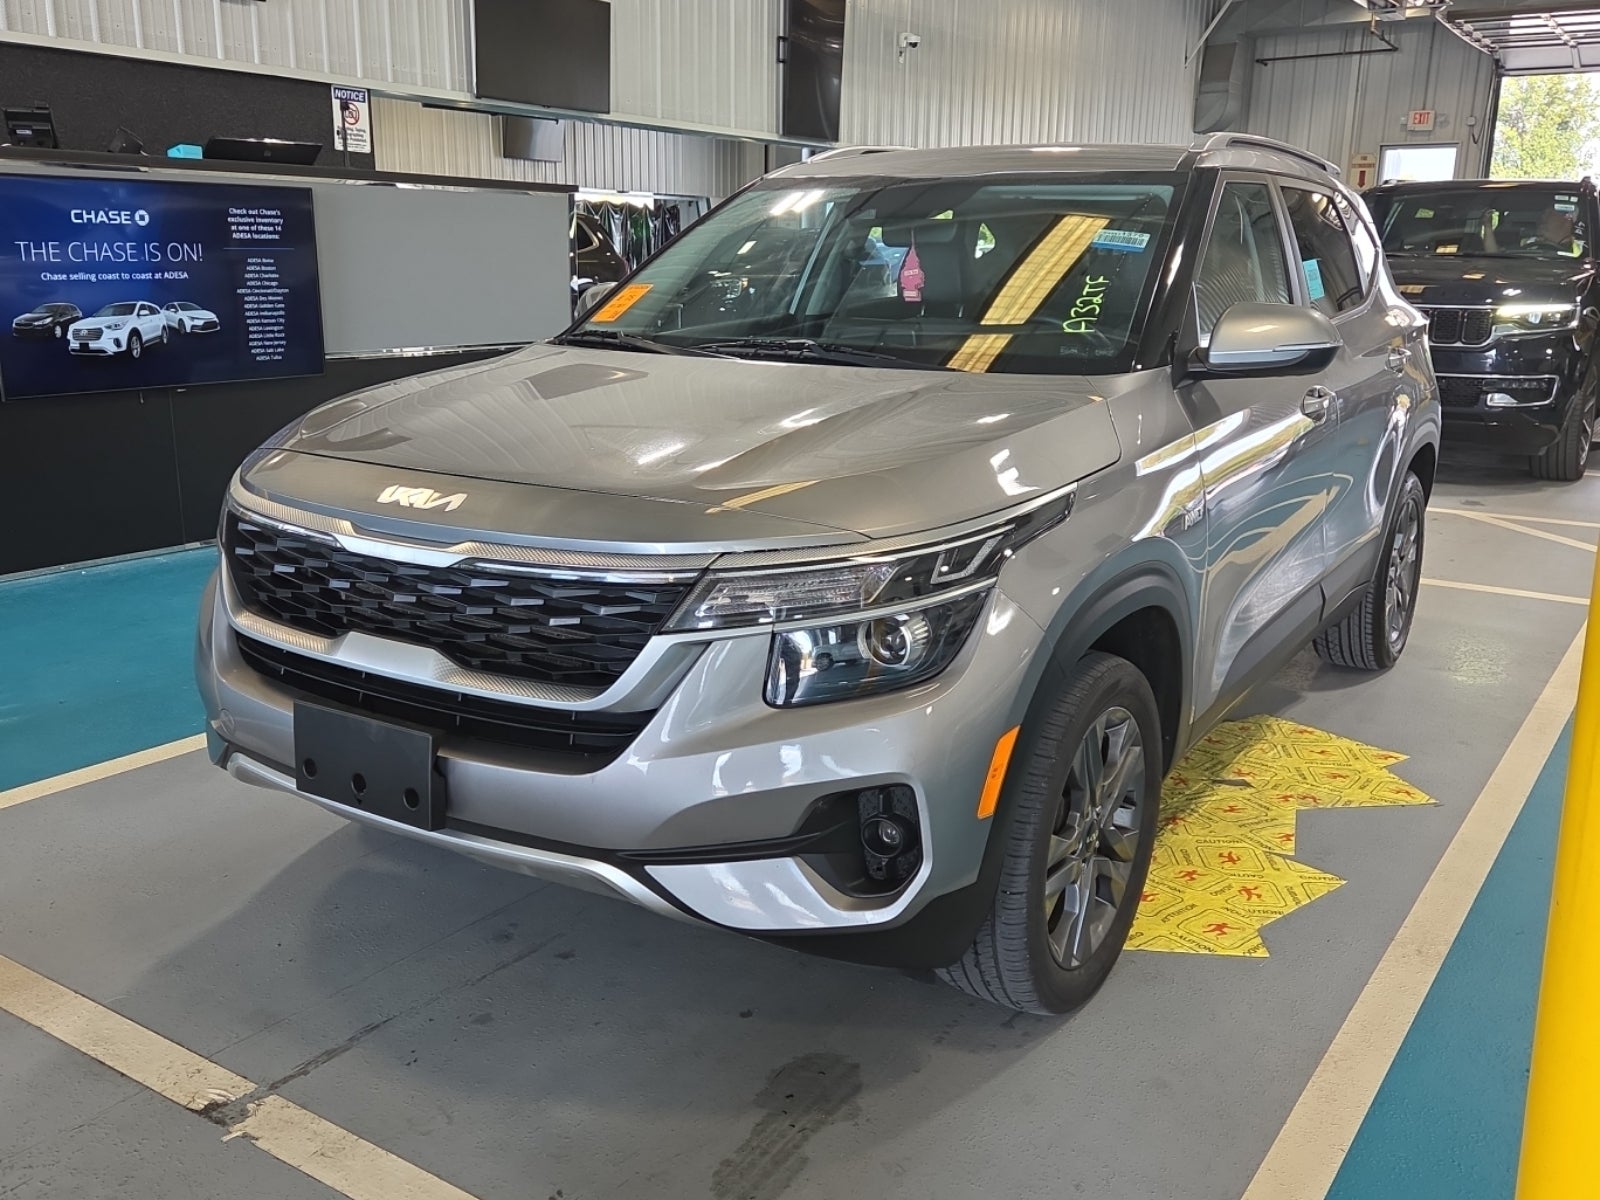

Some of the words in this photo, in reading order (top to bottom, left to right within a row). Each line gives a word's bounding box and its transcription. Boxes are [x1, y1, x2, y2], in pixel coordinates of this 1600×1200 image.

[335, 89, 364, 101] NOTICE
[1412, 112, 1430, 124] EXIT
[70, 209, 132, 224] CHASE
[14, 242, 60, 262] THE
[68, 242, 138, 262] CHASE
[144, 243, 161, 262] IS
[167, 243, 203, 262] ON!
[41, 272, 68, 281] Chase
[70, 272, 96, 282] selling
